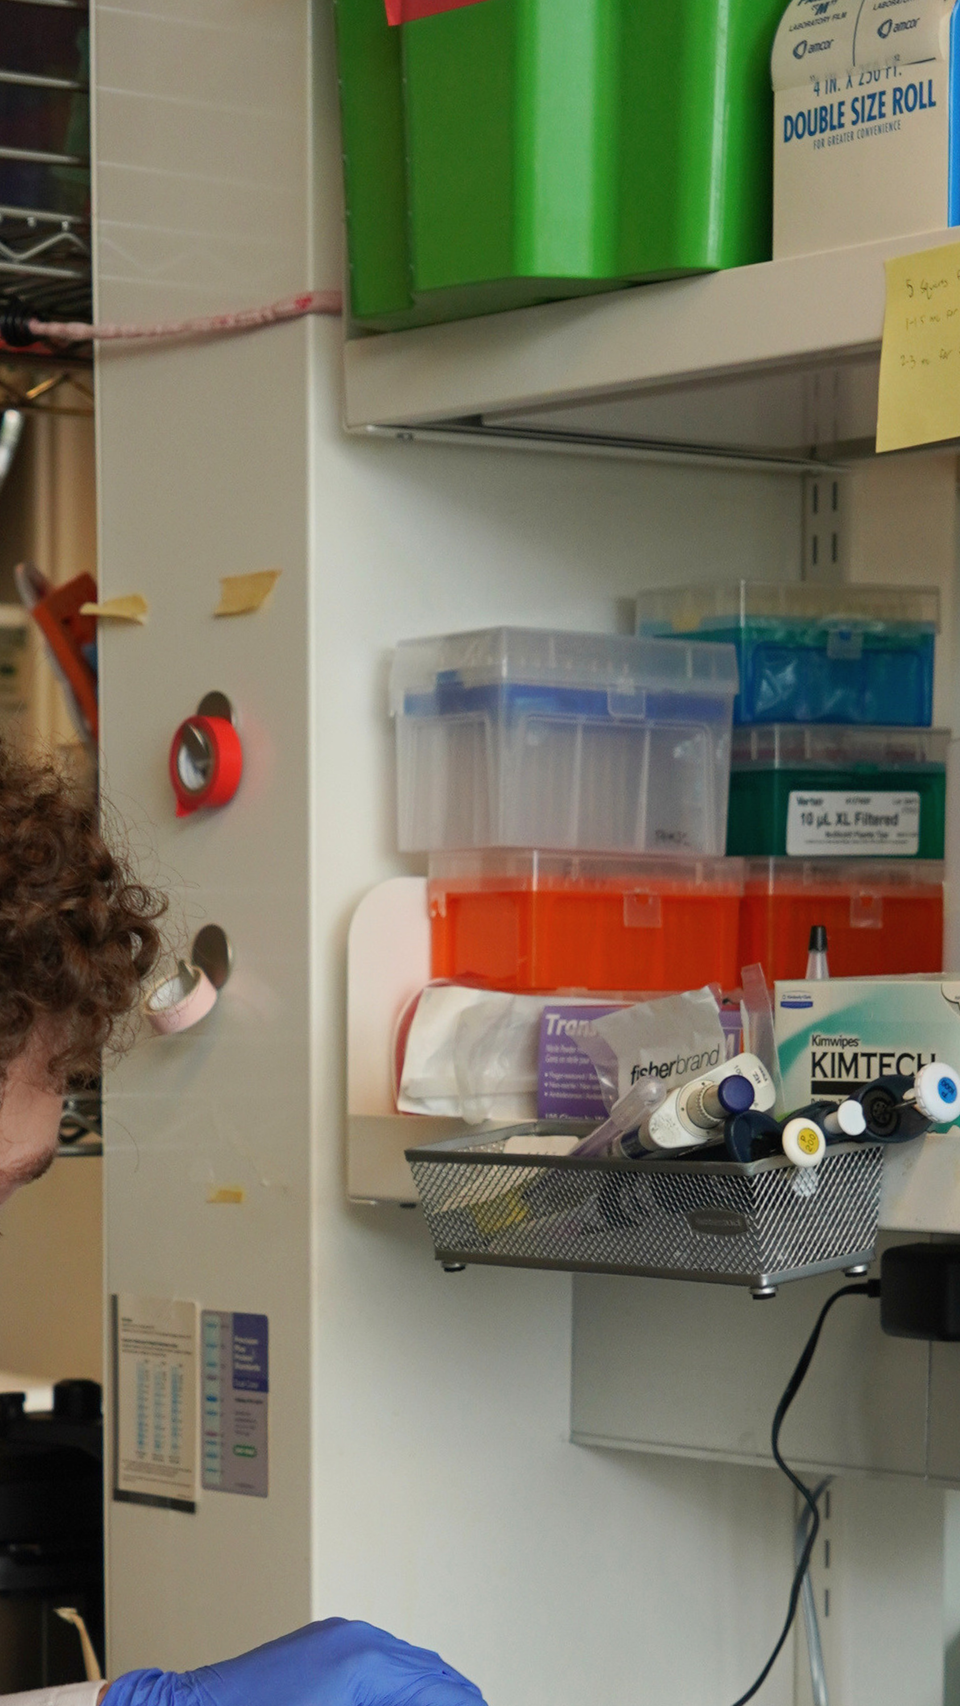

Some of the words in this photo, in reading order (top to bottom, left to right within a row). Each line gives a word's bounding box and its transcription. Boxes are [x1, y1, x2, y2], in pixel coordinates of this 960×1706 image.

[789, 16, 831, 32] LABORATORY
[832, 12, 848, 21] FILM
[893, 17, 921, 33] amcor
[807, 38, 834, 54] amcor
[783, 101, 846, 143] DOUBLE
[851, 90, 887, 126] SIZE
[892, 79, 937, 116] ROLL
[813, 138, 826, 151] FOR
[827, 131, 855, 147] GREATER
[856, 119, 902, 140] CONVENIENCE
[801, 812, 814, 826] 10
[835, 811, 851, 826] XL
[854, 811, 899, 826] Filtered
[630, 1043, 720, 1086] fisherbrand
[810, 1051, 936, 1080] KIMTECH
[800, 1134, 806, 1142] P
[805, 1133, 817, 1152] 200
